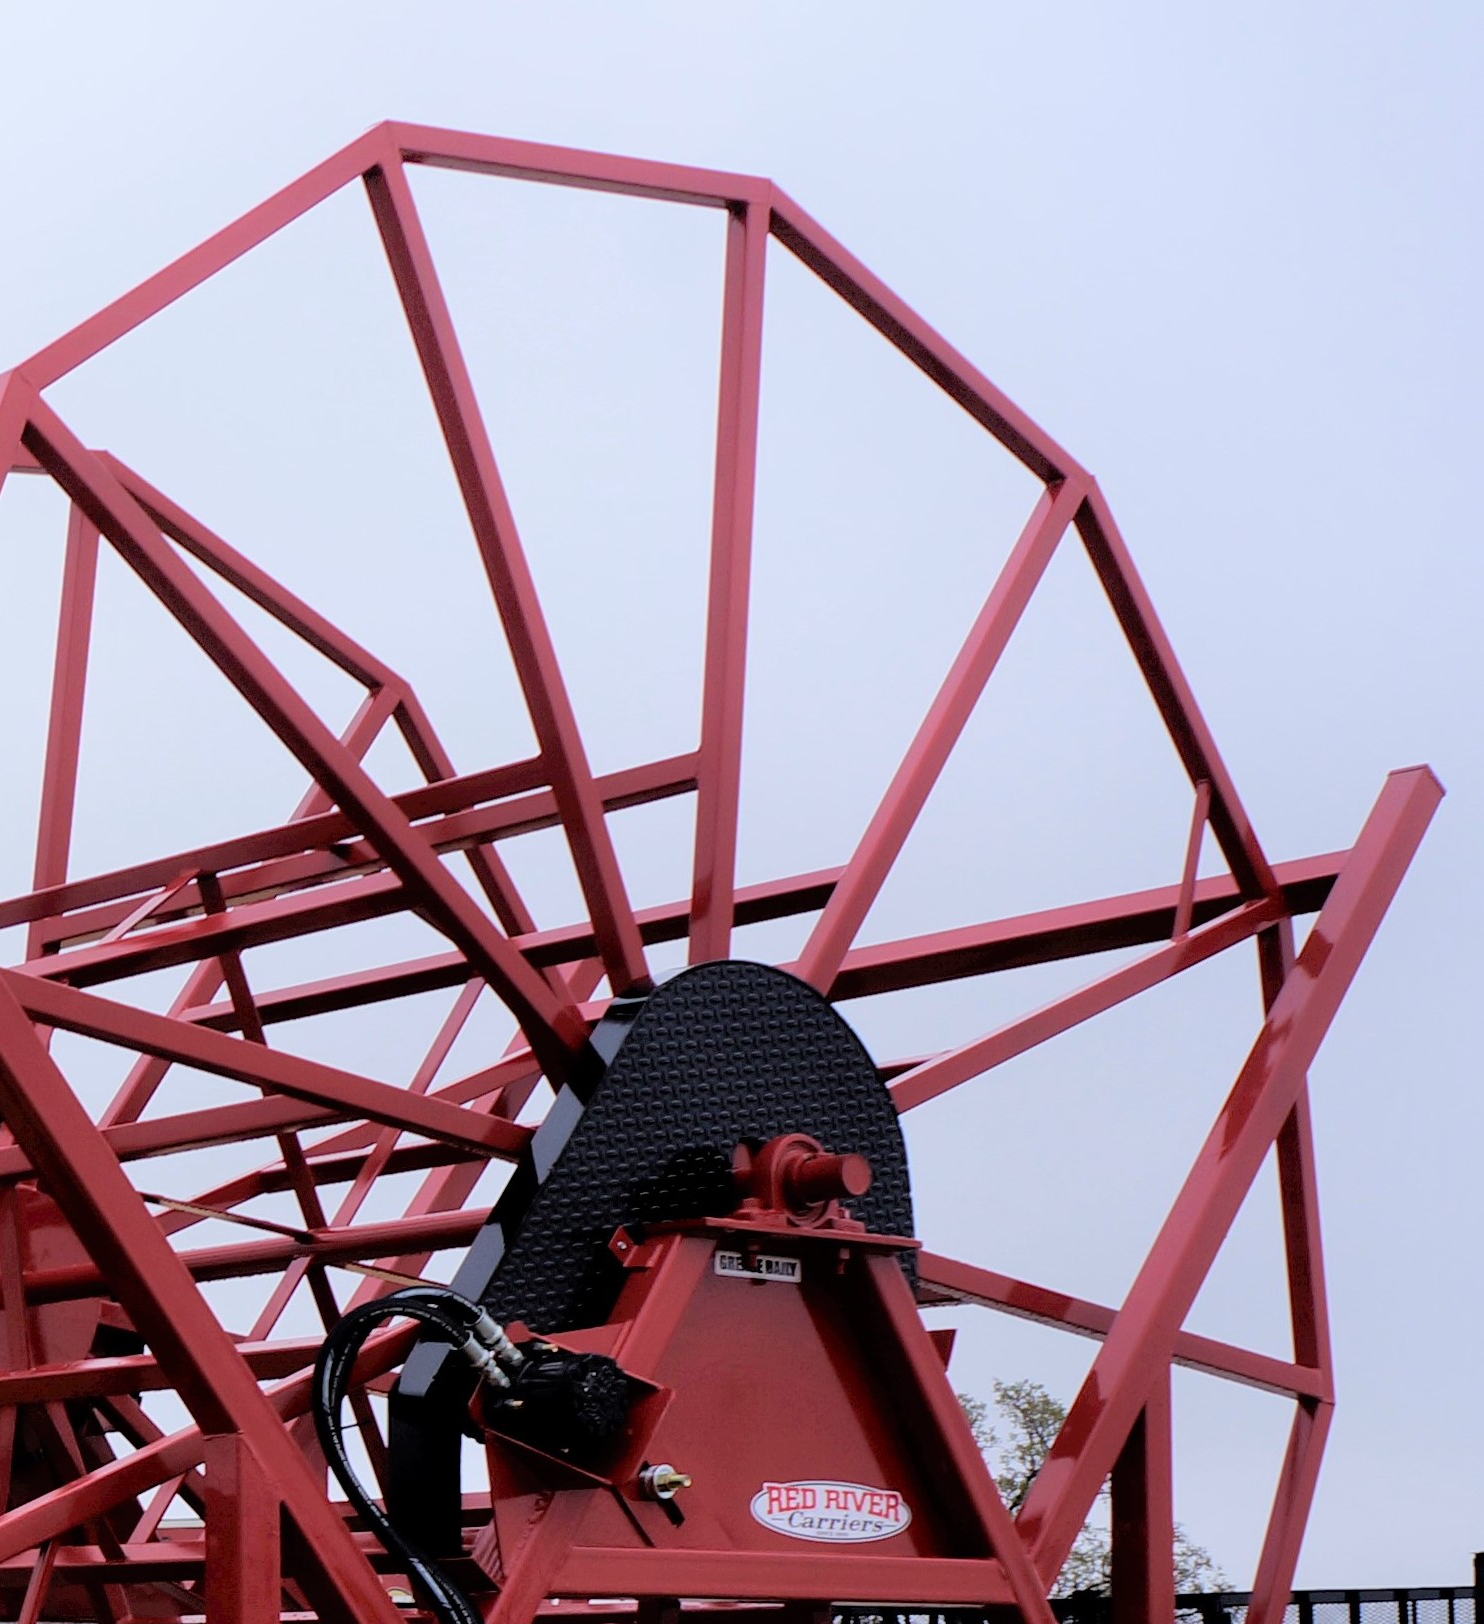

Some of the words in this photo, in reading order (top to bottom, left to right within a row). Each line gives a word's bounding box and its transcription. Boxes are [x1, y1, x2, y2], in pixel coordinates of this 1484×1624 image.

[720, 1254, 763, 1274] GREE
[766, 1485, 817, 1515] RED
[824, 1489, 900, 1522] RIVER
[787, 1510, 884, 1533] Carriers
